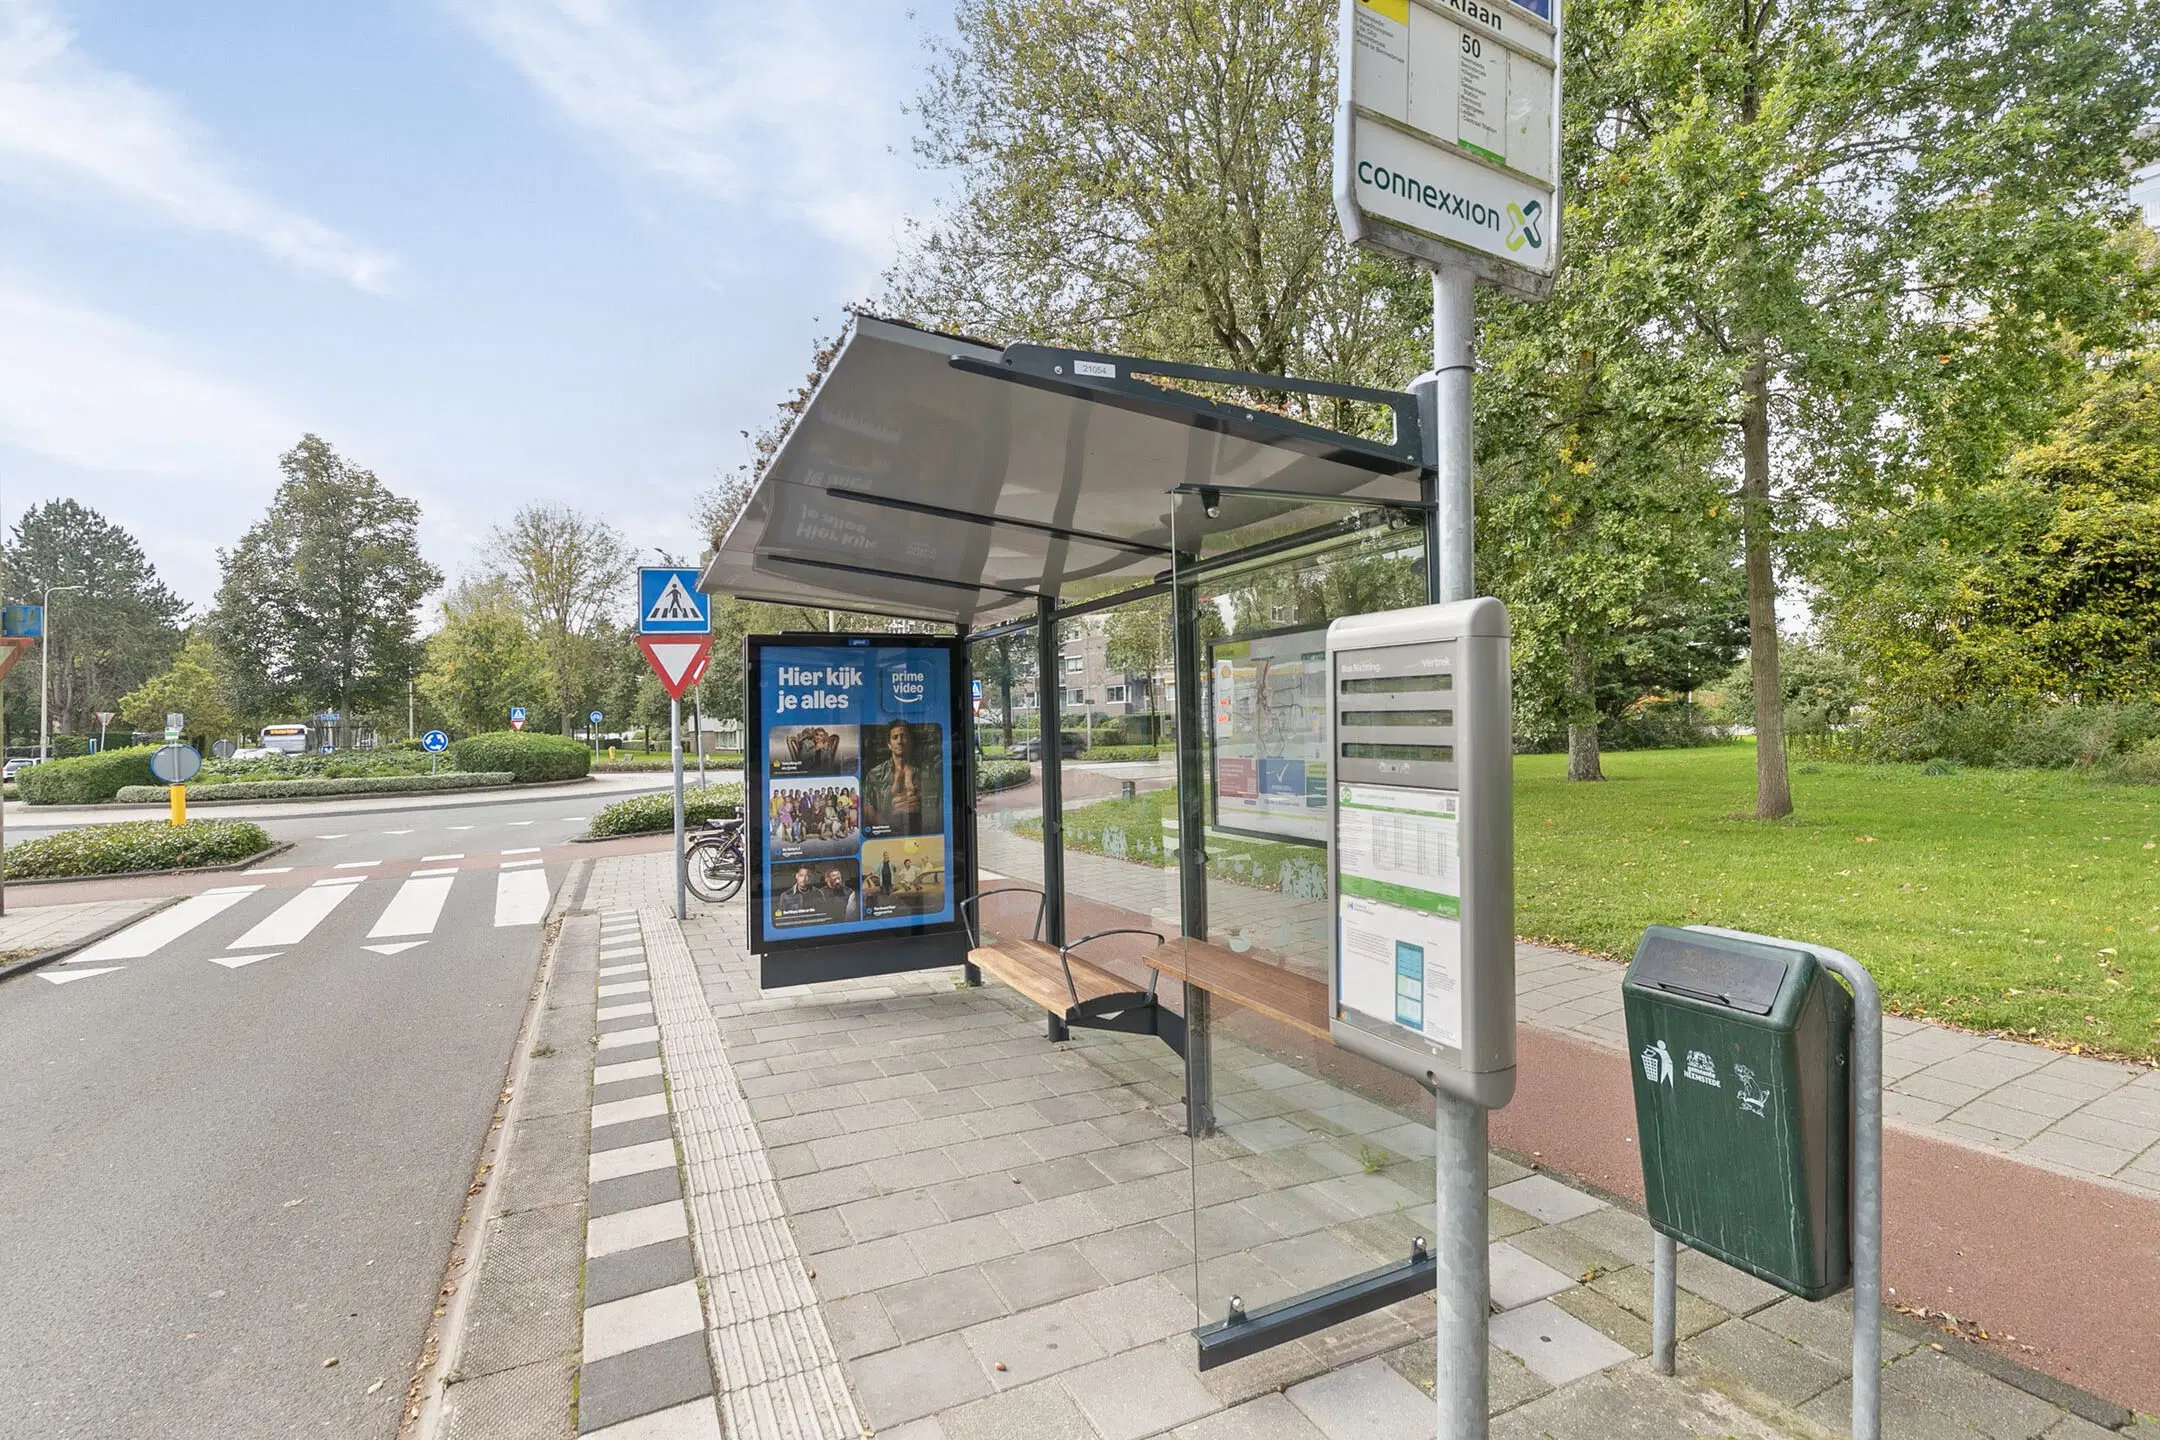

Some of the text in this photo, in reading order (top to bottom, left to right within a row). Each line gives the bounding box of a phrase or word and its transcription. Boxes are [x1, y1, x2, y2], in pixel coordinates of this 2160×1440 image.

[1461, 33, 1481, 58] 50
[1358, 161, 1500, 231] connexxion
[1082, 364, 1107, 375] 21054
[778, 666, 863, 689] Hier kijk
[892, 671, 924, 684] prime
[893, 683, 924, 694] video
[776, 690, 849, 714] je alles
[1683, 1069, 1721, 1088] HEEMSTEDE
